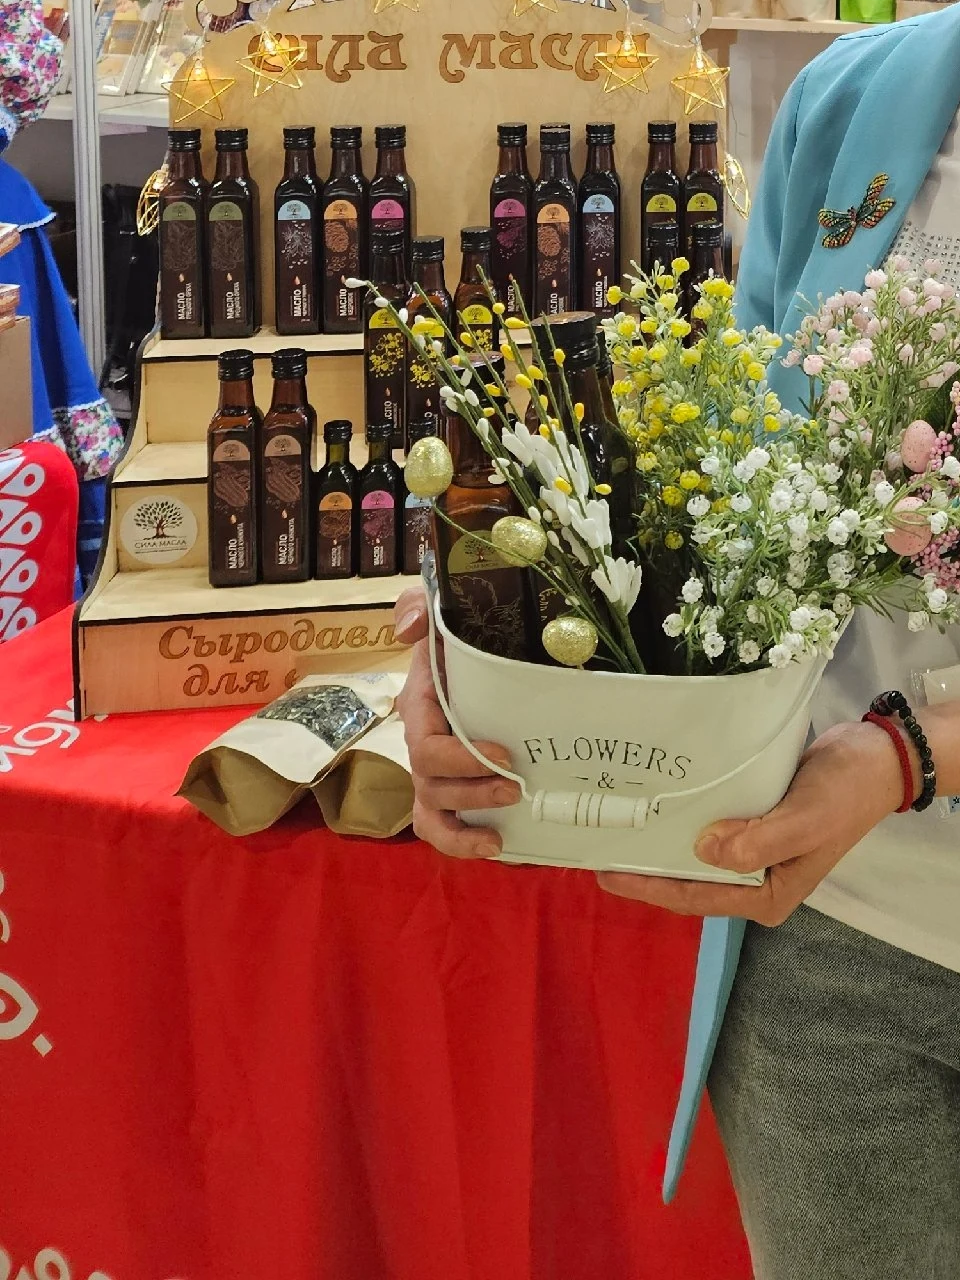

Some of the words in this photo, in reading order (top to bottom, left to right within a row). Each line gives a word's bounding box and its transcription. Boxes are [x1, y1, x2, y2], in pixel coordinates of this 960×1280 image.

[177, 292, 186, 320] МАСЛО
[226, 291, 235, 320] МАСЛО
[293, 289, 302, 317] МАСЛО
[339, 288, 348, 317] МАСЛО
[507, 285, 515, 312] МАСЛО
[549, 293, 558, 316] АСЛО
[595, 281, 603, 308] МАСЛО
[228, 538, 237, 569] МАСЛО
[278, 533, 288, 565] МАСЛО
[158, 619, 400, 663] Сыродавл
[182, 664, 269, 697] для
[523, 737, 691, 779] FLOWERS
